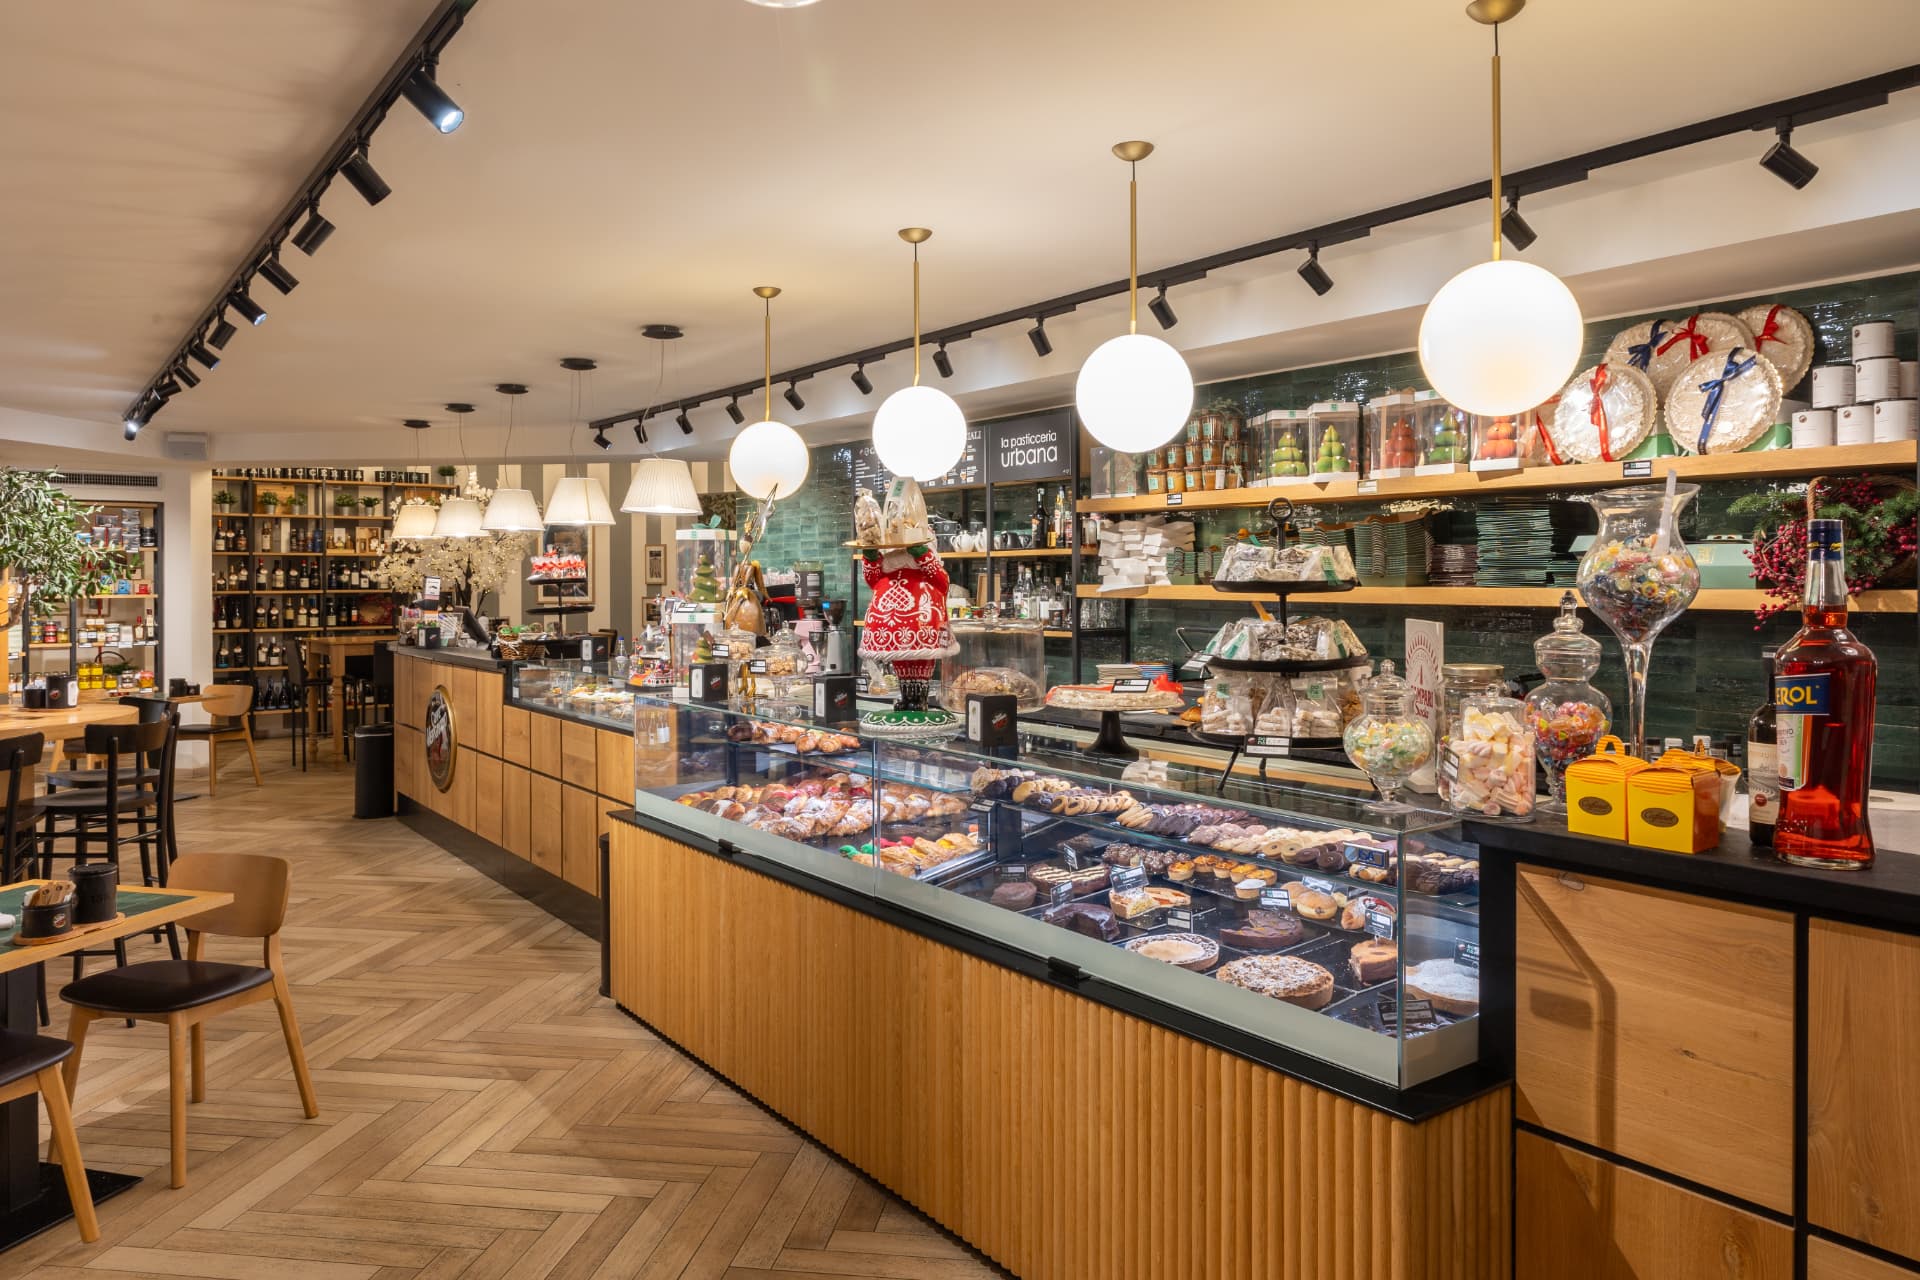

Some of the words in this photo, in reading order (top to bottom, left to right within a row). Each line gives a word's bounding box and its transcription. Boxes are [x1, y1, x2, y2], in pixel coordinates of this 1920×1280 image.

[1000, 437, 1009, 449] la
[1010, 429, 1057, 449] pasticceria
[1001, 445, 1058, 468] urbana
[1776, 685, 1818, 706] EROL
